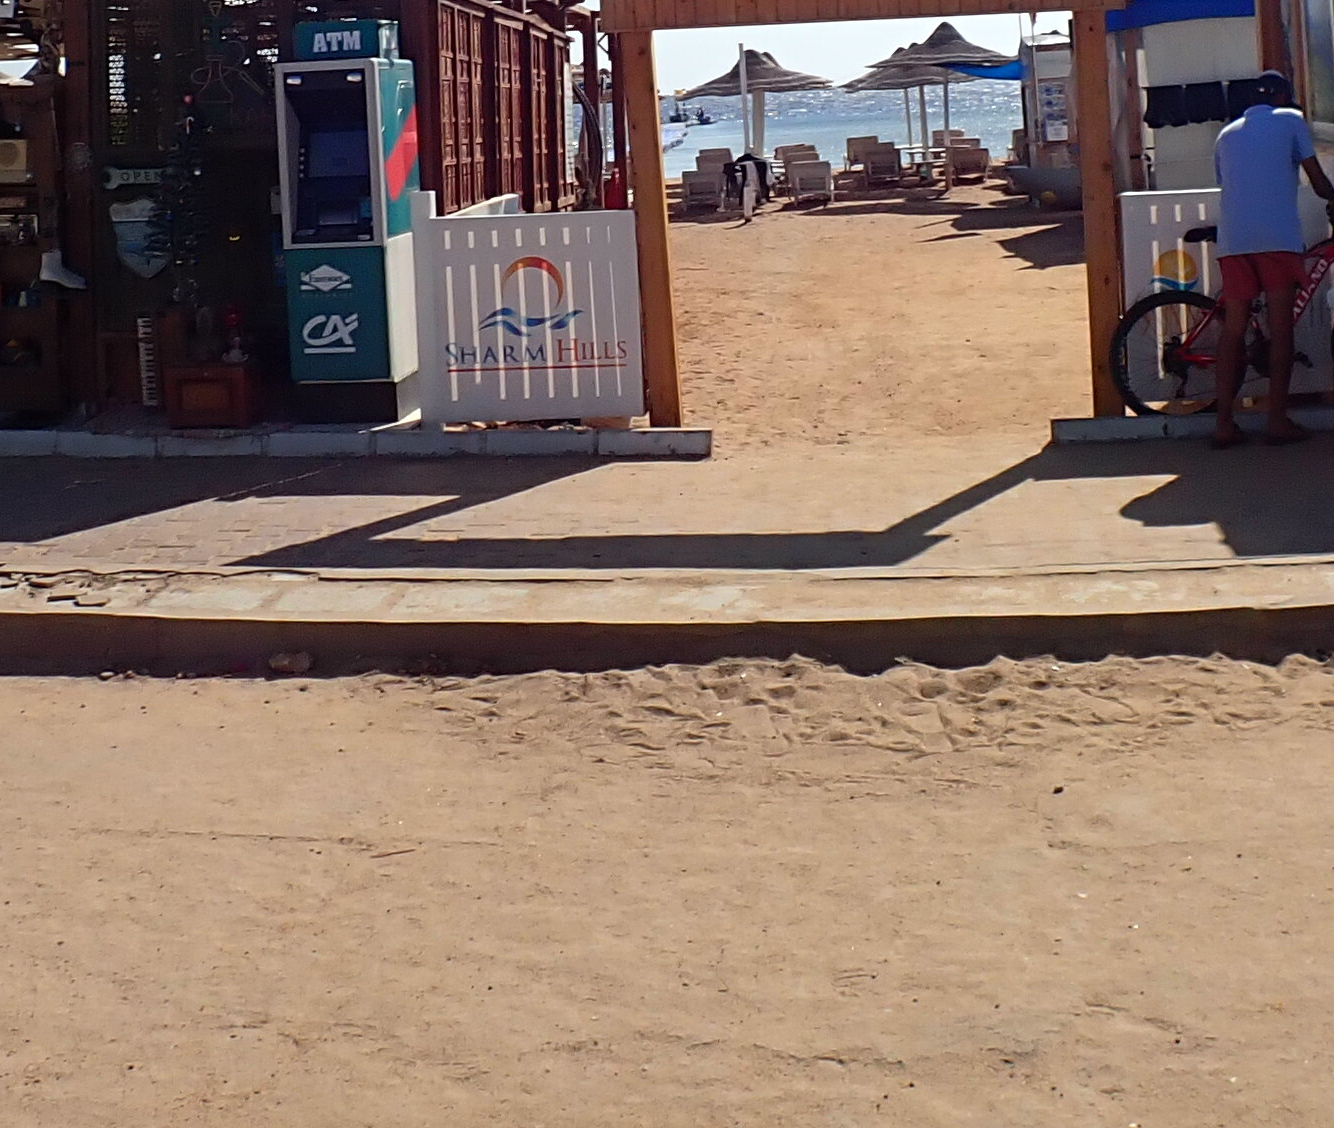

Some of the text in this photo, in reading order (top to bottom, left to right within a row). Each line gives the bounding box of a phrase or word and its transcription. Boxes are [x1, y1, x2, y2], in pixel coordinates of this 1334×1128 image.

[312, 30, 362, 53] ATM
[445, 338, 627, 367] SHARM HILLS
